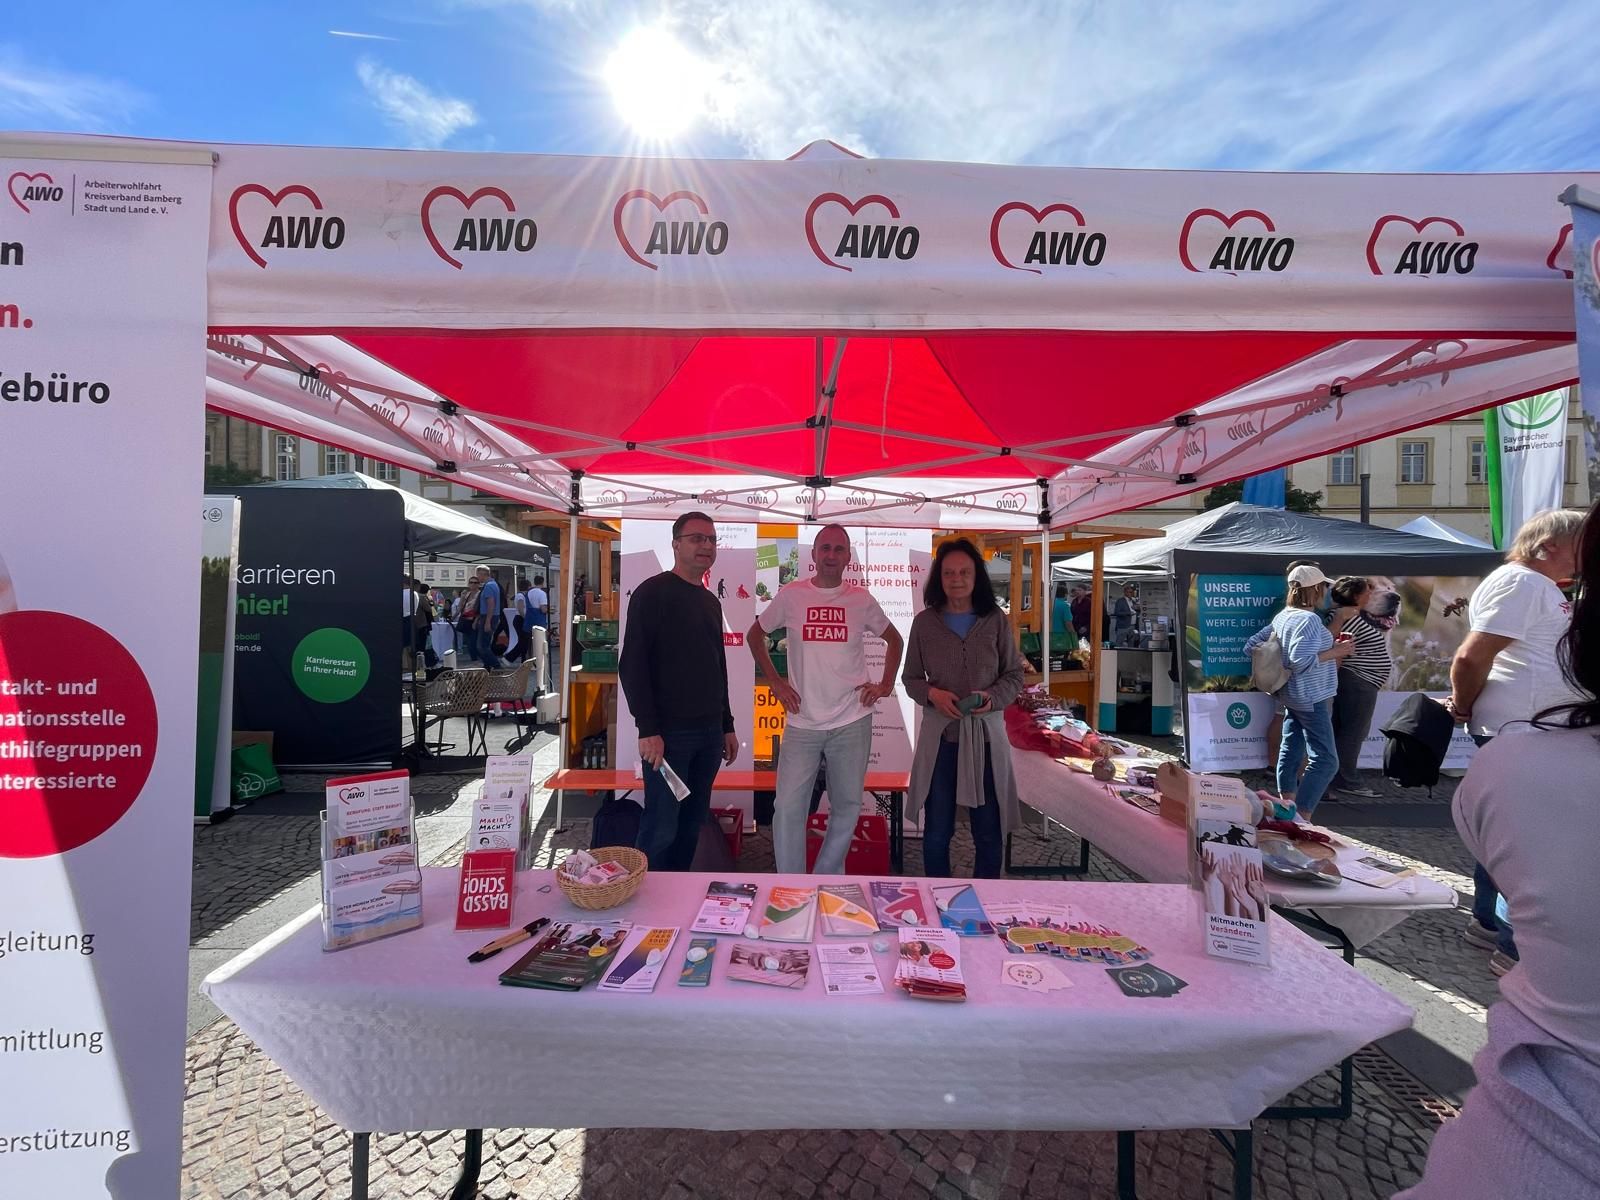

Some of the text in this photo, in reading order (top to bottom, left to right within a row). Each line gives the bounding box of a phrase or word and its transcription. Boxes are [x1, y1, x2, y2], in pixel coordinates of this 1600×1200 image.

[84, 180, 162, 192] Arbeiterwohlfahrt
[23, 186, 63, 202] AWO
[84, 192, 182, 205] Kreisverband Bamberg
[84, 204, 108, 213] Stadt
[109, 205, 126, 213] und
[128, 205, 149, 214] Land
[261, 215, 345, 249] AWO
[454, 218, 538, 252] AWO
[644, 220, 729, 255] AWO
[834, 223, 920, 260] AWO
[1024, 231, 1107, 266] AWO
[1209, 236, 1294, 271] AWO
[1394, 241, 1479, 275] AWO
[0, 371, 110, 403] ebüro
[847, 562, 865, 572] FÜR
[867, 564, 905, 573] ANDERE
[907, 564, 920, 573] DA
[860, 578, 871, 587] ES
[874, 576, 894, 587] FÜR
[895, 579, 918, 588] DICH
[1204, 582, 1251, 593] UNSERE
[809, 608, 844, 621] DEIN
[1205, 619, 1239, 628] WERTE,
[1240, 619, 1255, 627] DIE
[806, 626, 846, 640] TEAM
[1219, 636, 1236, 644] jeder
[306, 655, 356, 667] Karrierestart
[303, 664, 357, 677] in Ihrer Hand!
[57, 678, 98, 695] und
[0, 709, 126, 727] ationsstelle
[0, 771, 117, 790] teressierte
[347, 791, 365, 800] AWO
[479, 822, 512, 831] MACHT'S
[462, 876, 506, 895] SCHO!
[463, 892, 509, 913] BASSD
[1210, 916, 1257, 930] Mitmachen.
[1210, 925, 1255, 938] Verändern.
